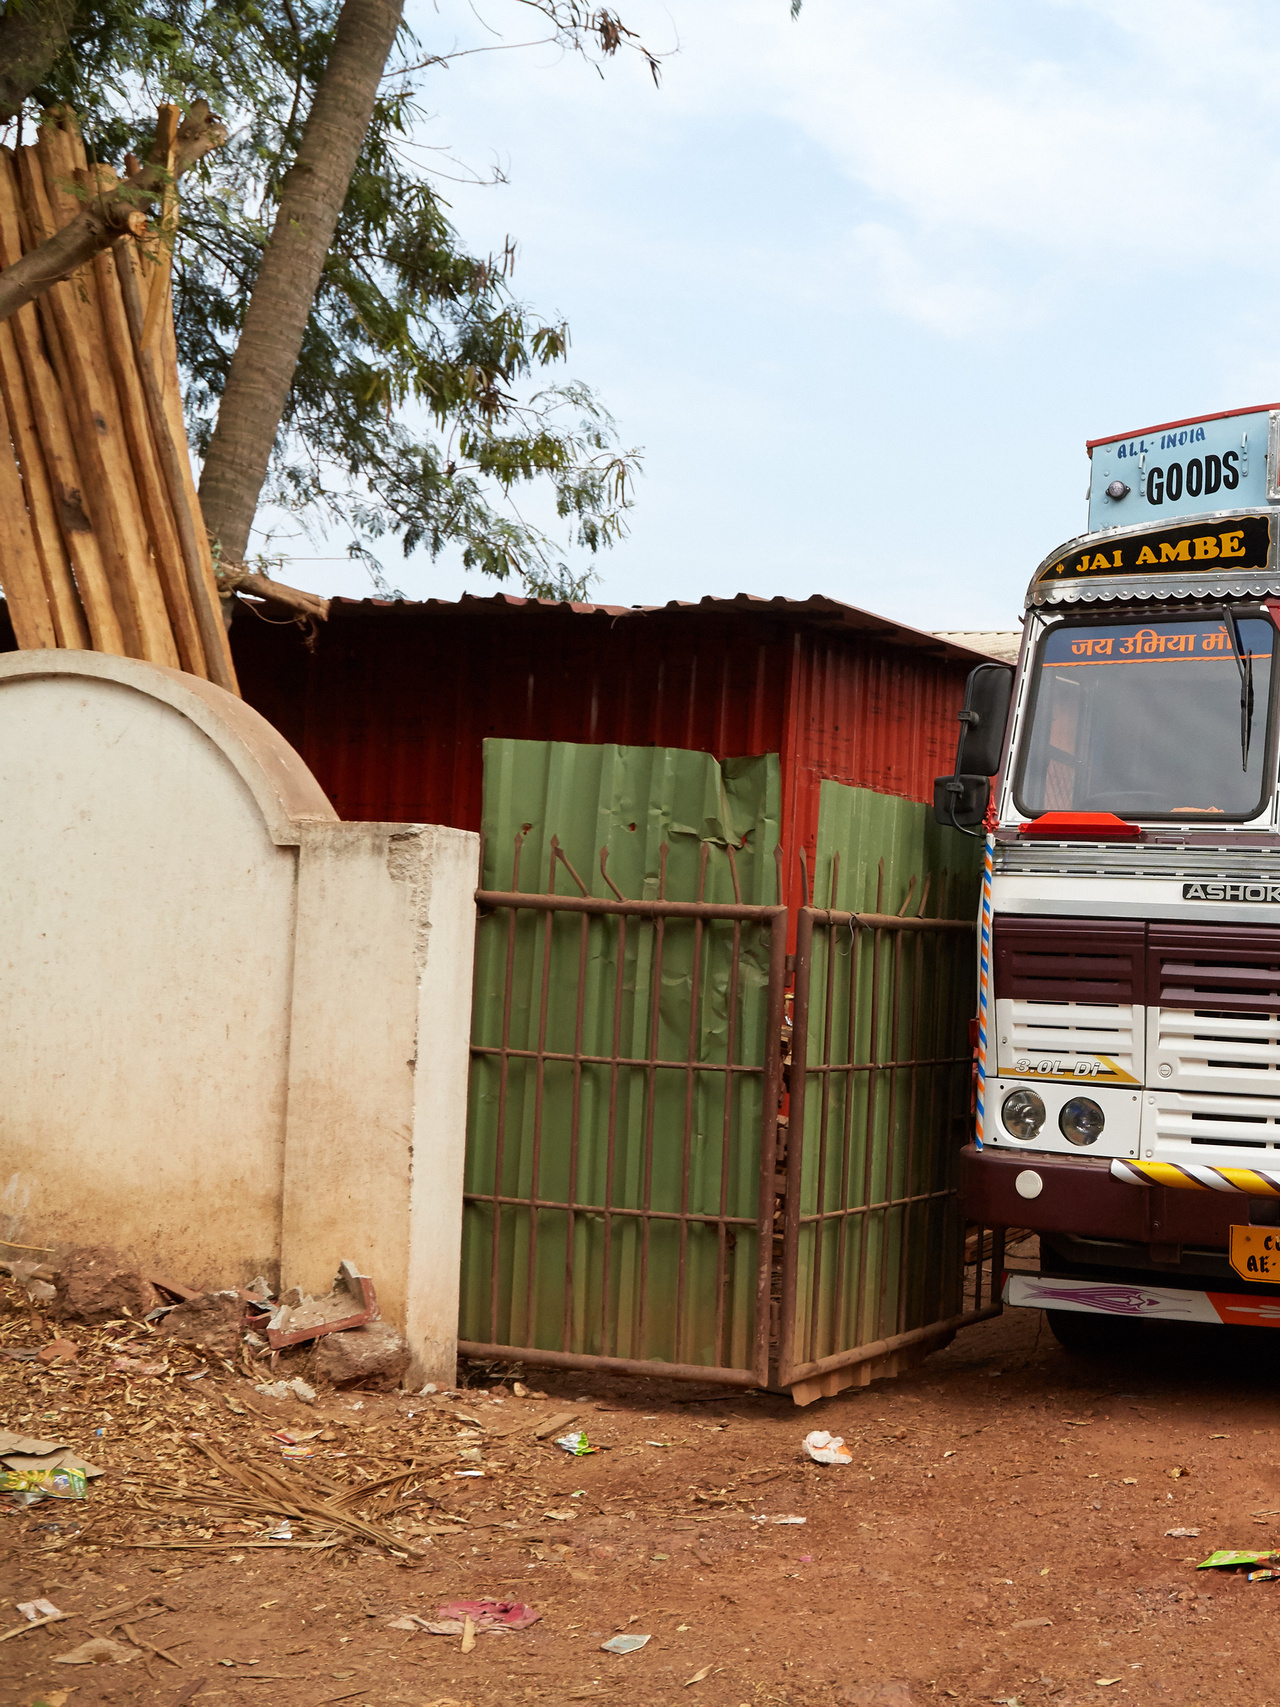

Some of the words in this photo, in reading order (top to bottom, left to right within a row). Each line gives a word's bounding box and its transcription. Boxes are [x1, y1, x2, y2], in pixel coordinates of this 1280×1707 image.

[1161, 427, 1206, 450] INDIA
[1146, 450, 1240, 506] GOODS
[1076, 550, 1124, 572] JAI
[1135, 530, 1246, 565] AMBE
[1071, 638, 1115, 656] जय
[1119, 629, 1197, 655] उमिया
[1014, 1058, 1065, 1076] 3.0L
[1073, 1061, 1102, 1078] Di
